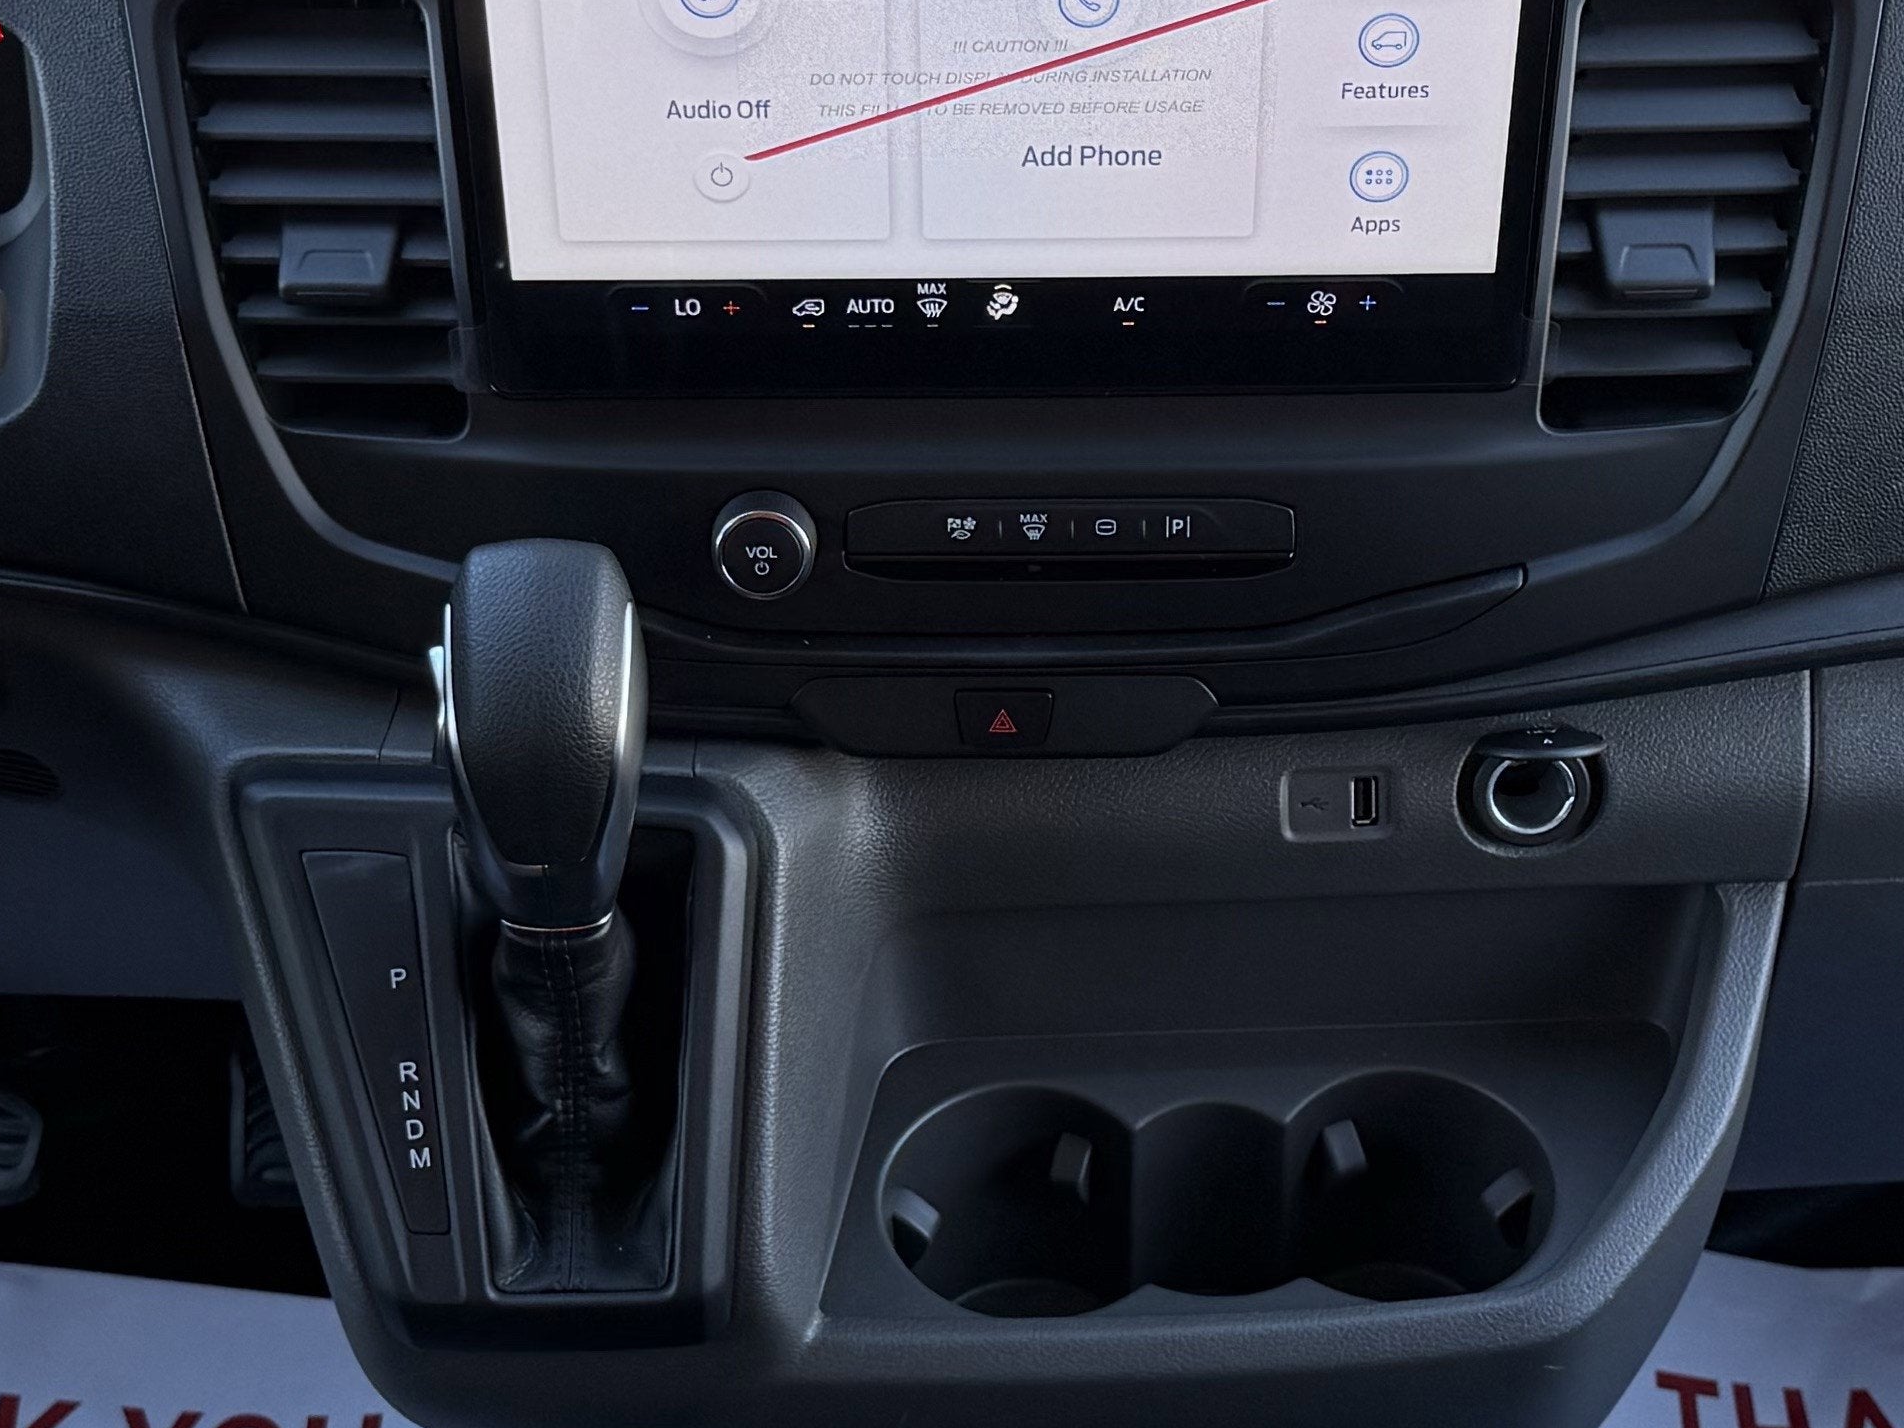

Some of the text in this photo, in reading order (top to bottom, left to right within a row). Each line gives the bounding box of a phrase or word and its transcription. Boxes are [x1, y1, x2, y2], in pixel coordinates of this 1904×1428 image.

[972, 39, 1050, 53] CAUTION
[810, 73, 836, 86] DO
[840, 73, 878, 86] NOT
[882, 72, 941, 85] TOUCH
[945, 71, 1014, 85] DISPL
[1090, 68, 1212, 83] INSTALLATION
[1341, 78, 1431, 102] Features
[666, 97, 771, 121] Audio Off
[817, 104, 856, 118] THIS
[952, 102, 975, 115] BE
[980, 101, 1066, 115] REMOVED
[1069, 101, 1141, 114] BEFORE
[1144, 100, 1205, 113] USAGE
[1022, 145, 1163, 168] Add Phone
[1351, 214, 1401, 237] Apps
[917, 282, 946, 294] MAX
[675, 300, 700, 317] LO
[846, 298, 895, 314] AUTO
[1113, 296, 1145, 314] A/C
[1019, 513, 1048, 524] MAX
[745, 546, 779, 560] VOL
[390, 969, 407, 989] P
[399, 1062, 419, 1082] R
[402, 1091, 421, 1111] N
[406, 1119, 424, 1140] D
[409, 1147, 431, 1170] M
